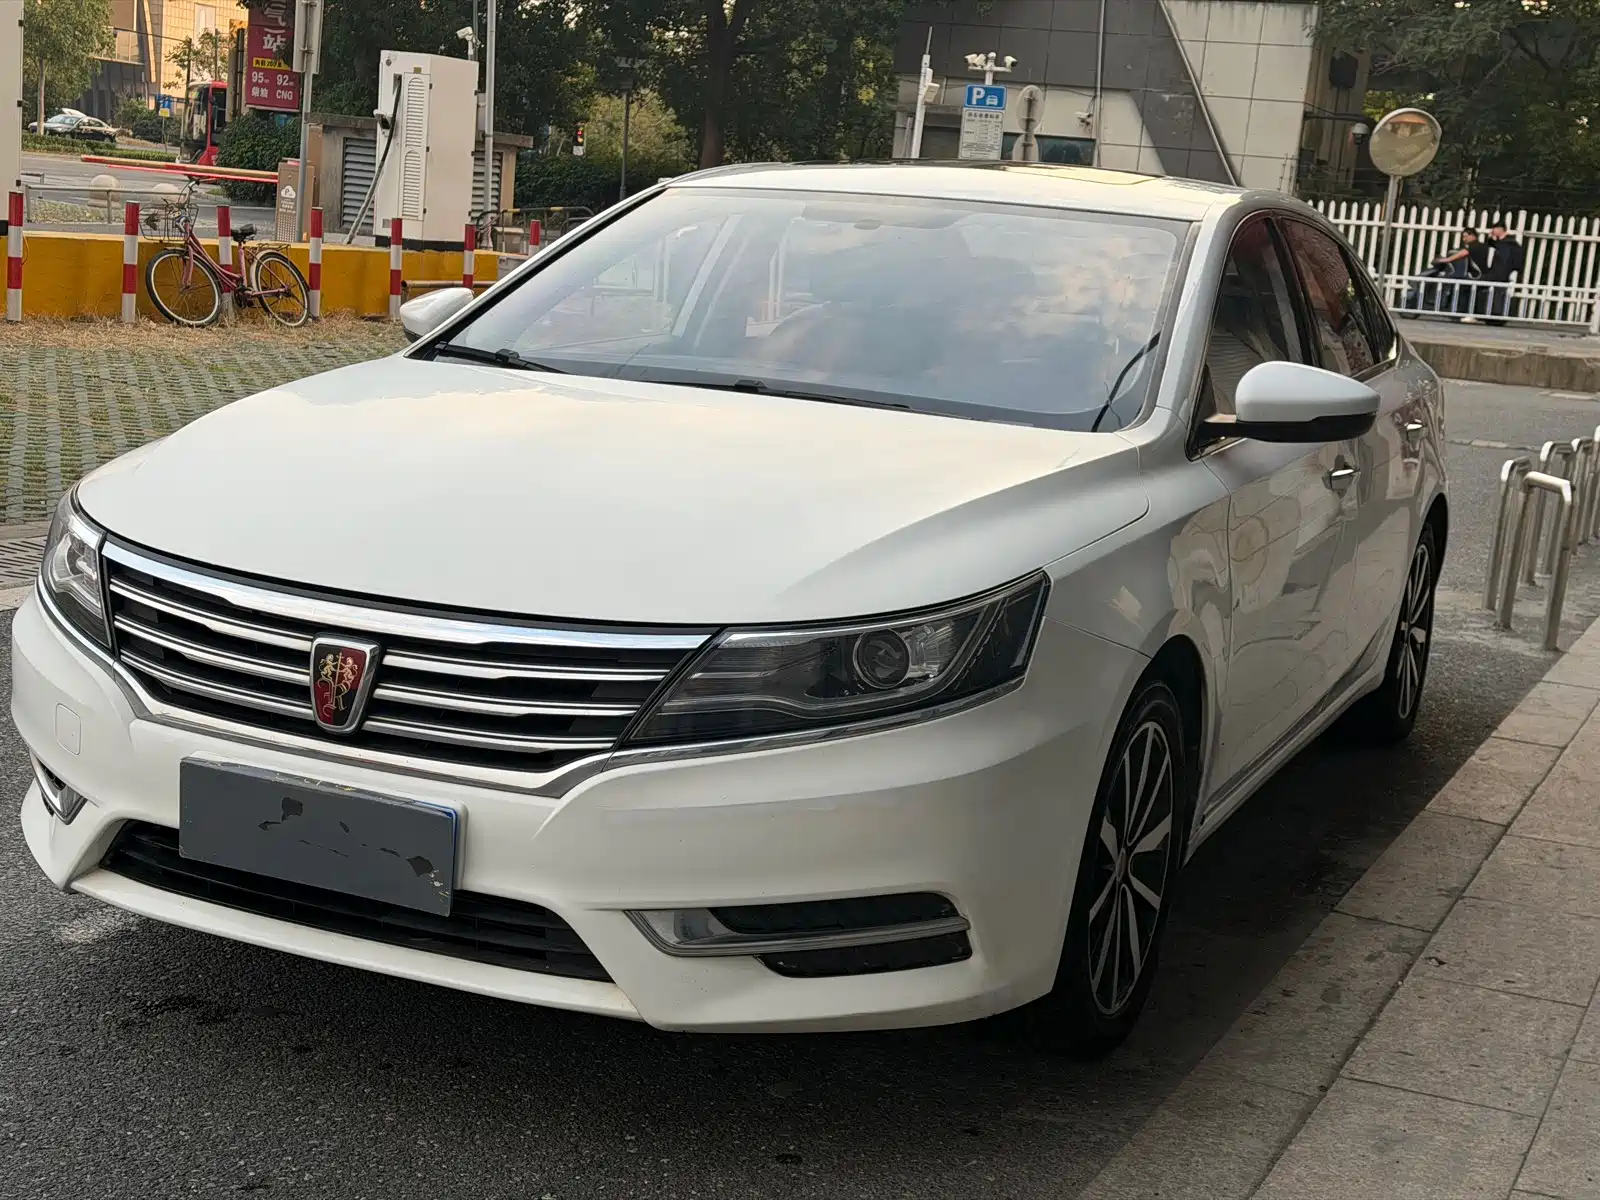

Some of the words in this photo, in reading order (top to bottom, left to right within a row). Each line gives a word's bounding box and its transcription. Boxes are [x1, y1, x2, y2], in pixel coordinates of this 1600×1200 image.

[252, 71, 264, 83] 95
[277, 74, 289, 86] 92
[276, 89, 293, 101] CNG
[972, 87, 985, 105] P
